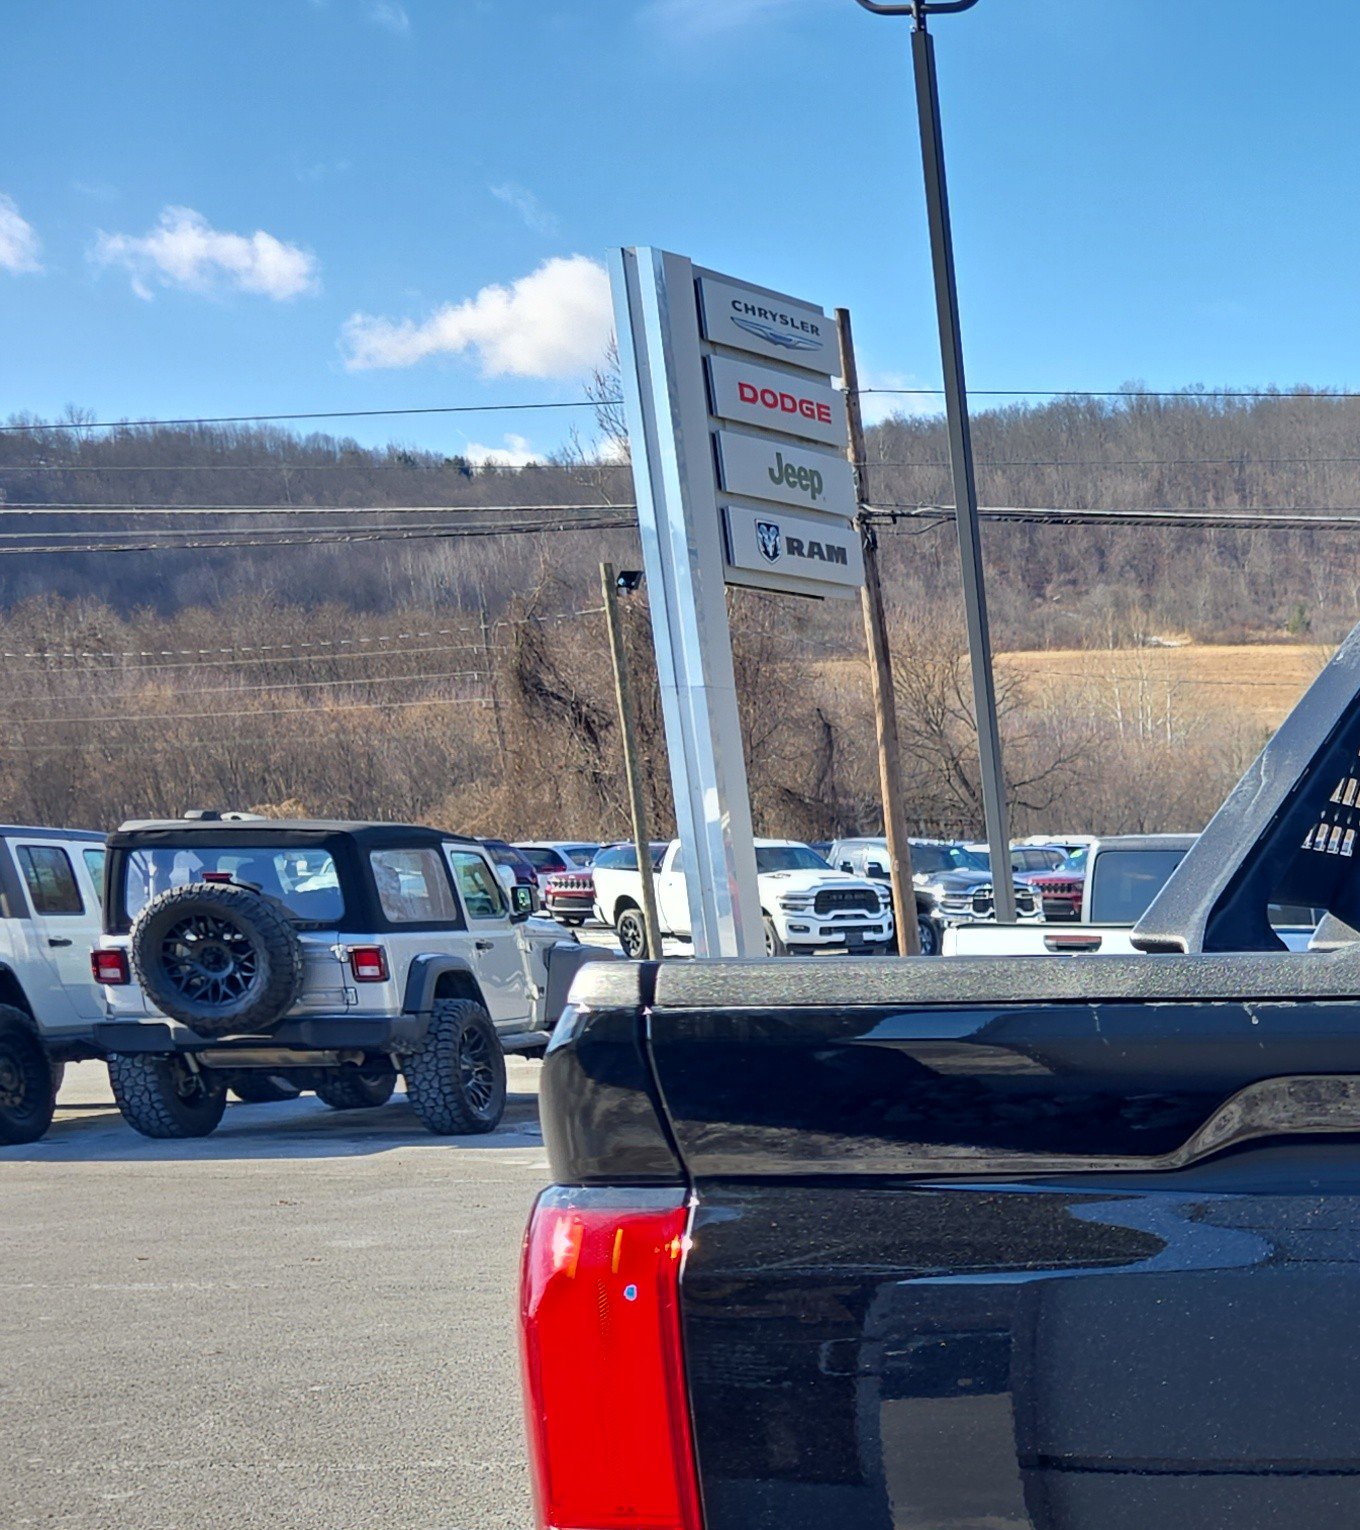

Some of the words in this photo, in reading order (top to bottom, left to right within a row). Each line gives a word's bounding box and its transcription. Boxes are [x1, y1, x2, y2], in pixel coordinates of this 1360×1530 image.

[731, 299, 821, 337] CHRYSLER
[738, 381, 832, 424] DODGE
[768, 452, 824, 500] Jeep
[785, 536, 848, 566] RAM
